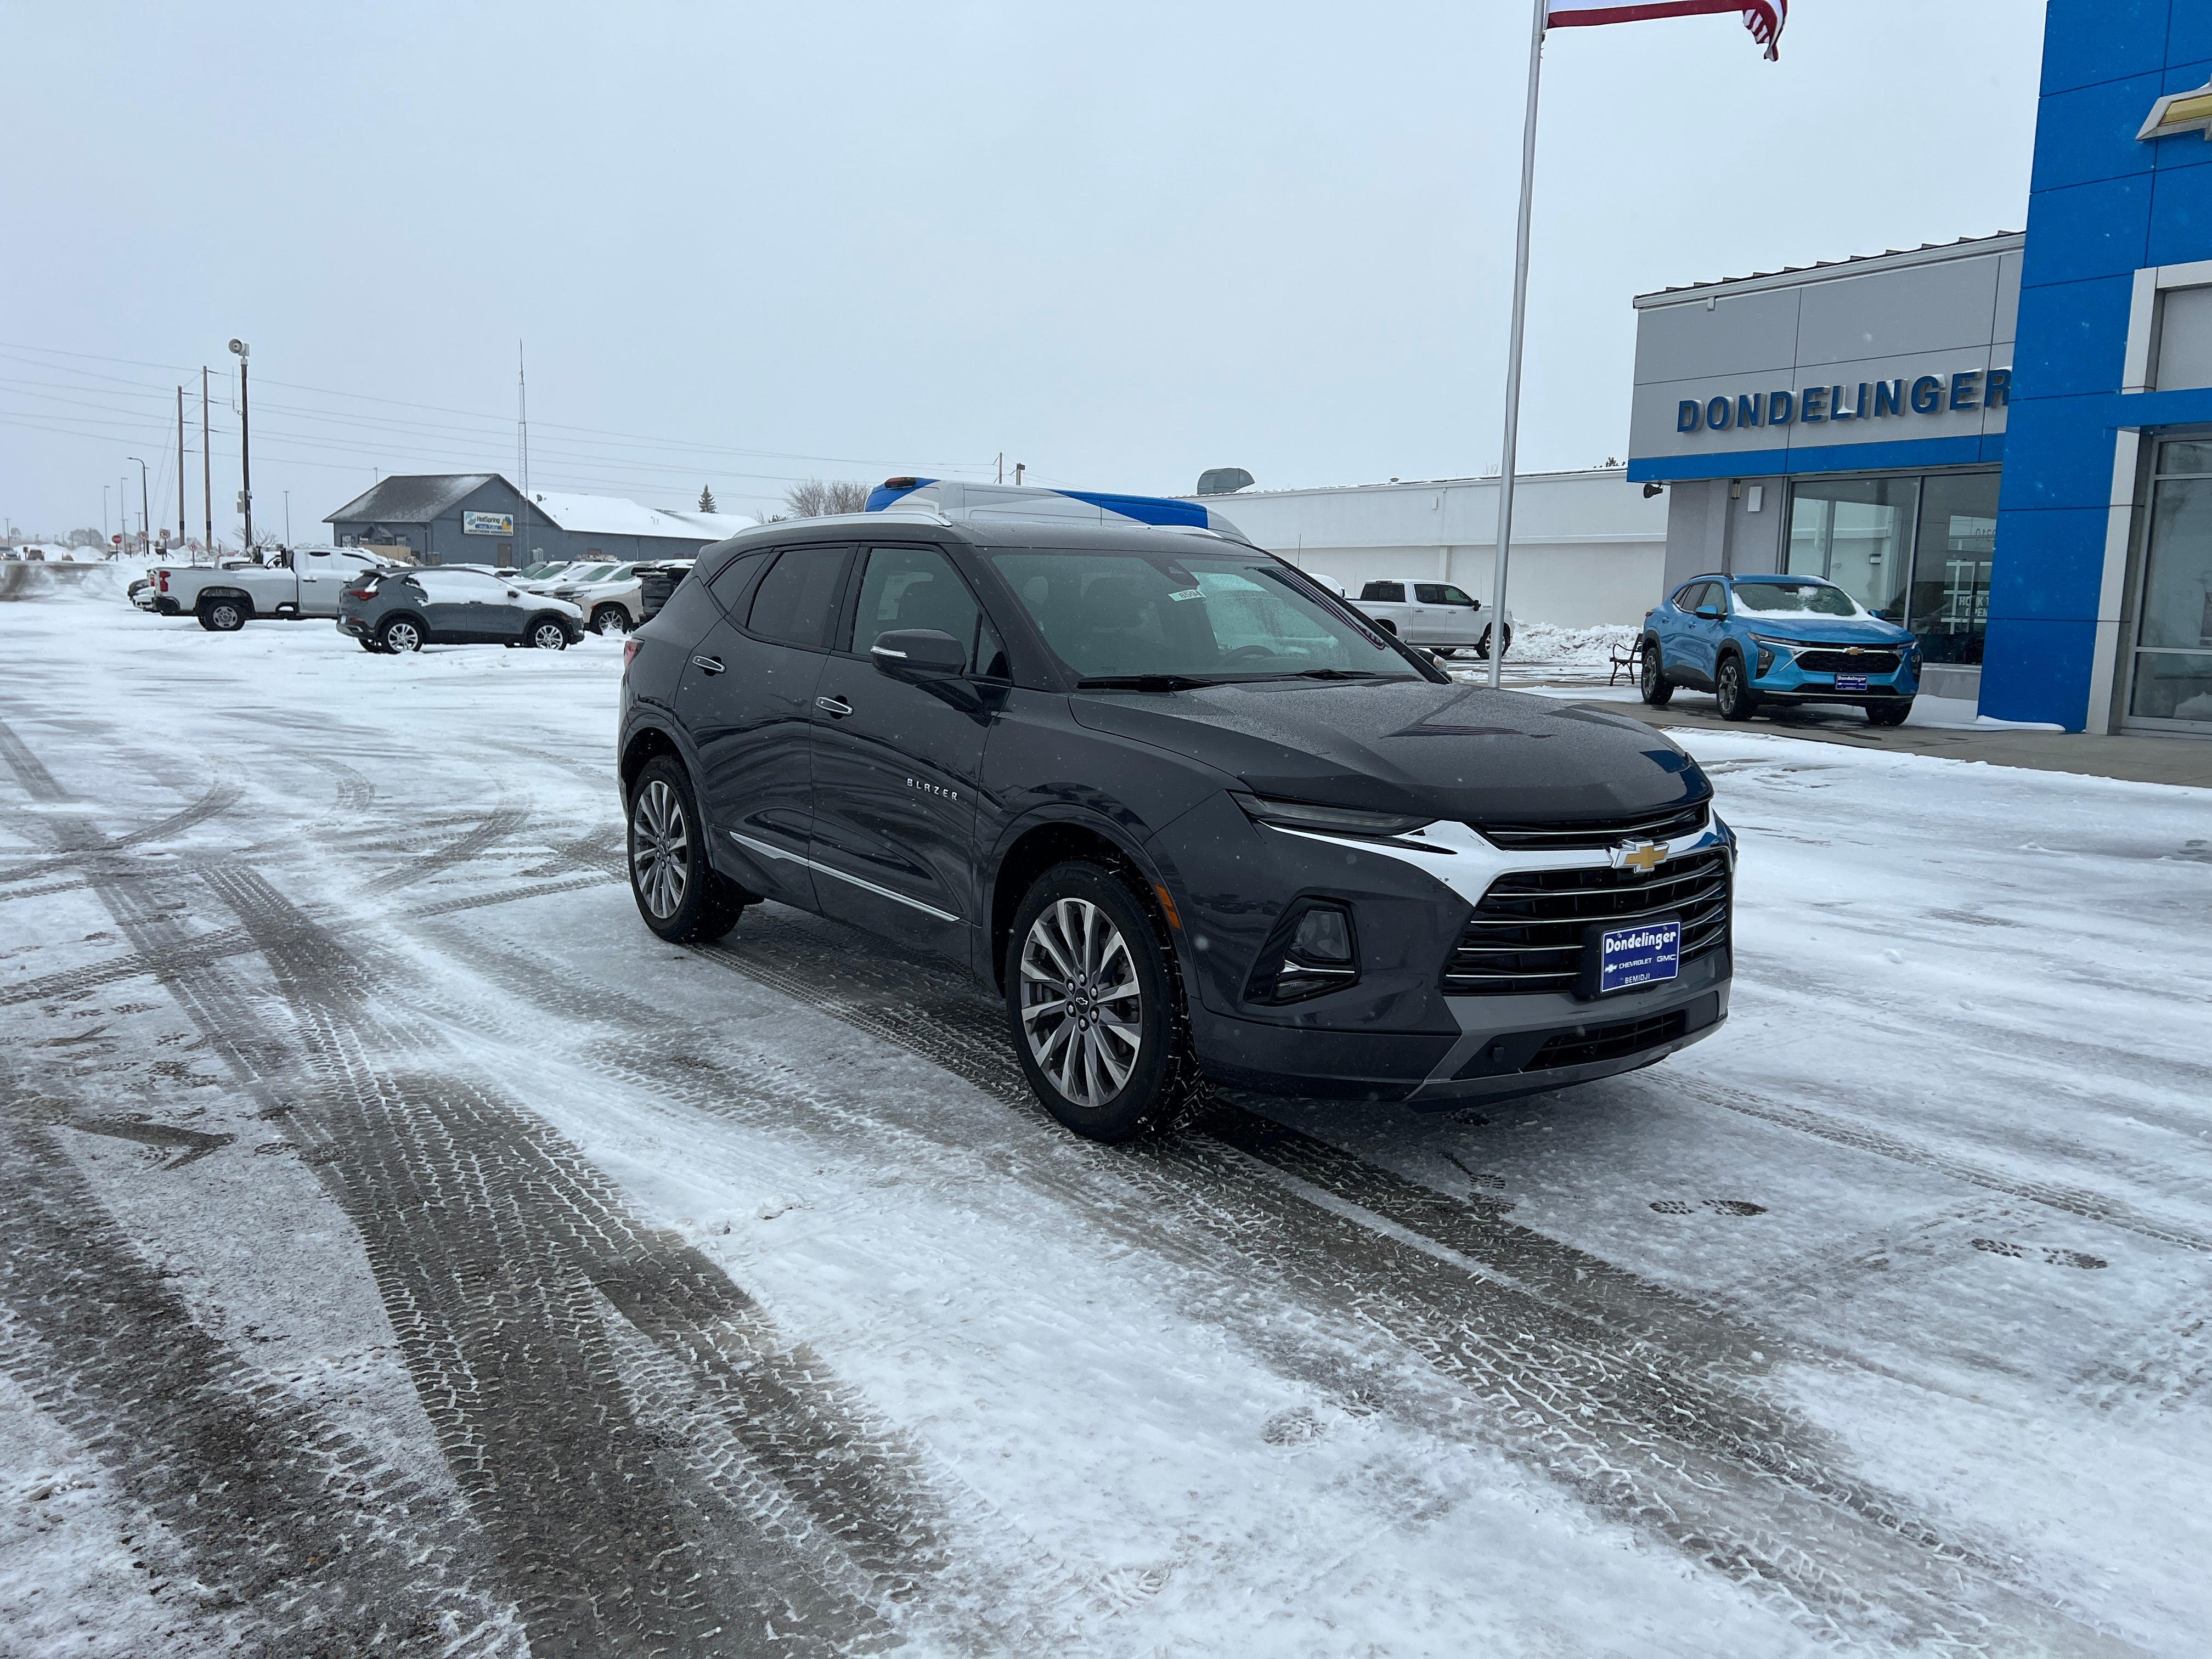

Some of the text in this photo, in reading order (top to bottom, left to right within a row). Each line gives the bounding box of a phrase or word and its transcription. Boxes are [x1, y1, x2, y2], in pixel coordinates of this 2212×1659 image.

[1677, 369, 2011, 432] DONDELINGER
[477, 516, 500, 524] HotSpring
[907, 778, 958, 801] BLAZER
[1605, 932, 1677, 954] Dondelinger
[1619, 954, 1676, 969] CHEVROLET GMC
[1624, 973, 1650, 984] BEMIDJI
